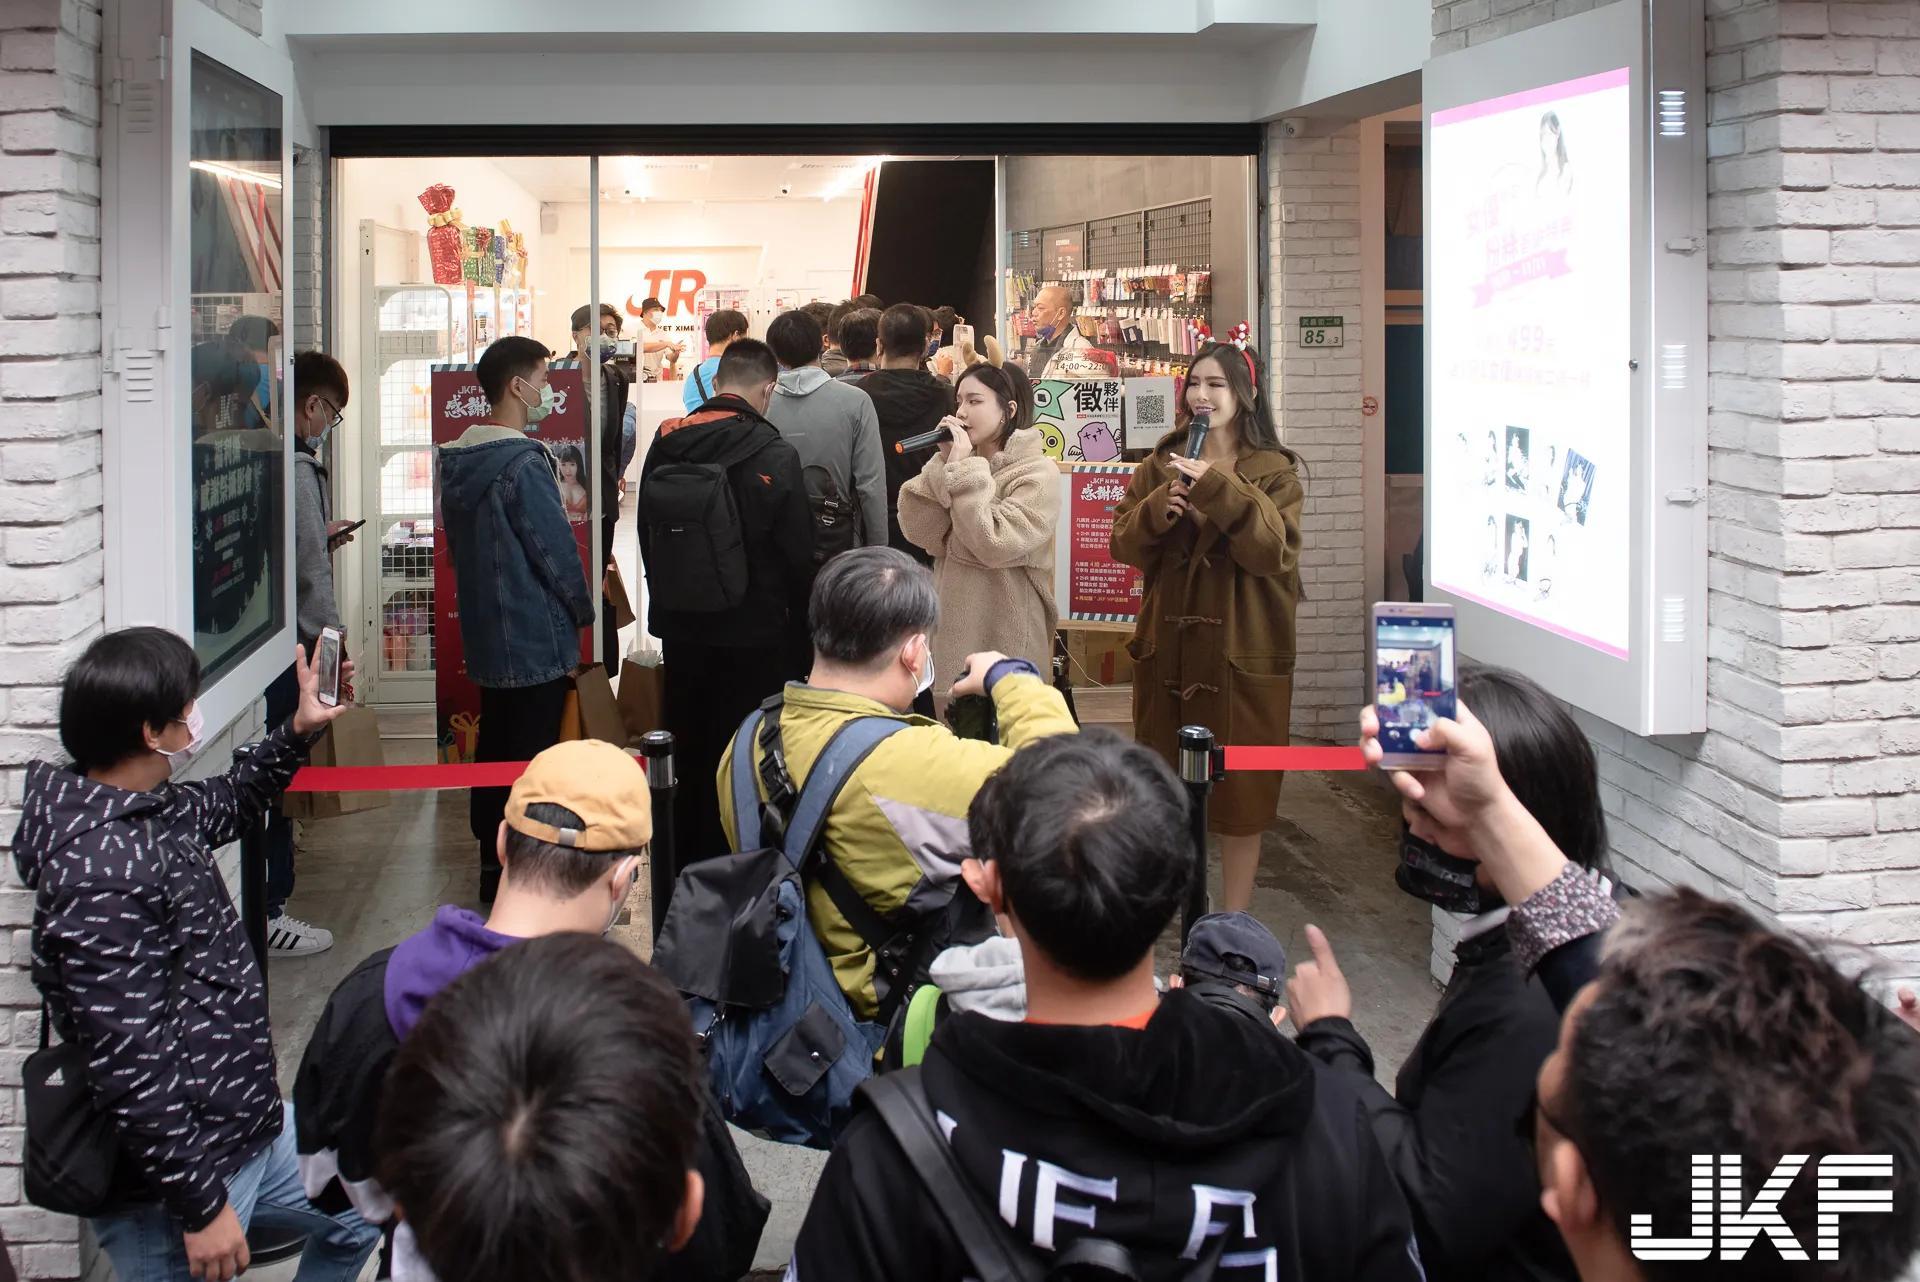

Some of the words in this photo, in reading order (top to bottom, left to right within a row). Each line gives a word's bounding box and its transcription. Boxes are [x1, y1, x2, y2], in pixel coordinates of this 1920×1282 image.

[626, 269, 707, 317] JR
[1304, 329, 1325, 344] 85
[458, 386, 478, 394] JKF
[444, 394, 492, 418] 感謝
